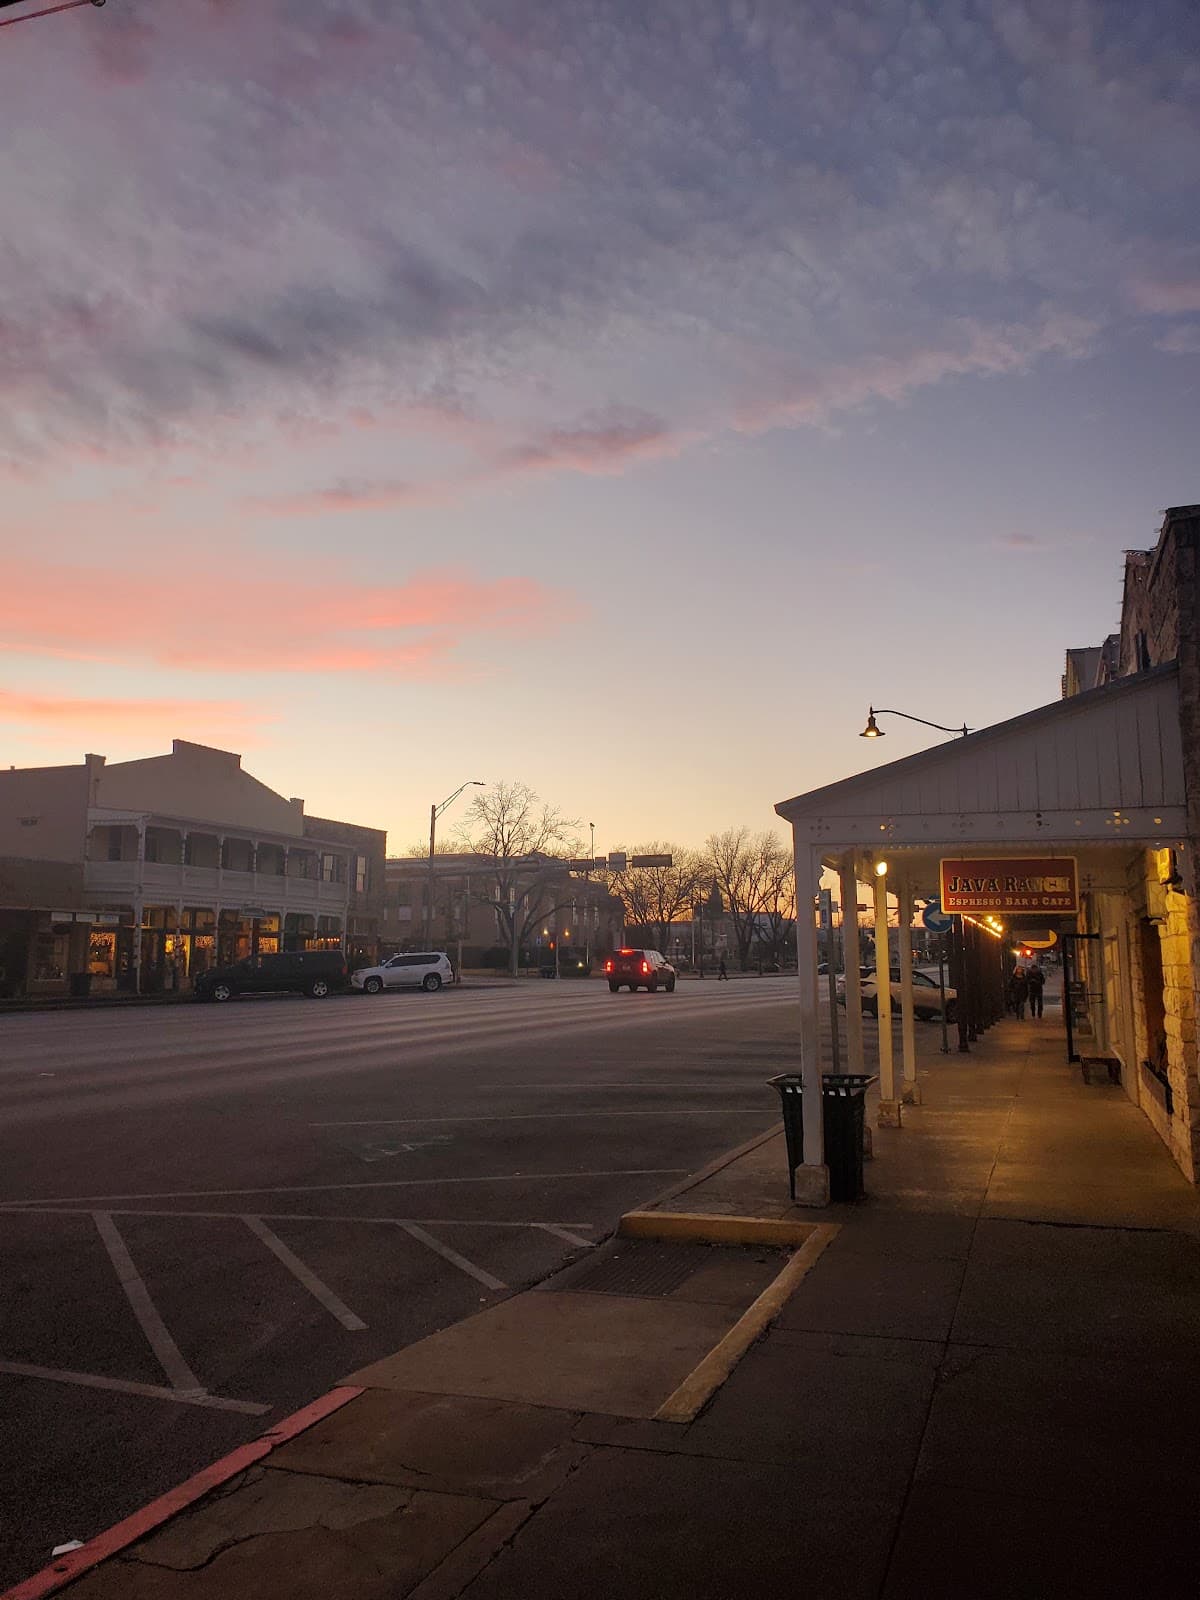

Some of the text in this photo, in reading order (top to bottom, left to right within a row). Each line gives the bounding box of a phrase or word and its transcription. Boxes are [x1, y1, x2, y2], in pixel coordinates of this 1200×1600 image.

[948, 876, 1001, 892] JAVA
[949, 897, 1001, 906] ESPRESSO
[1005, 897, 1029, 906] BAR
